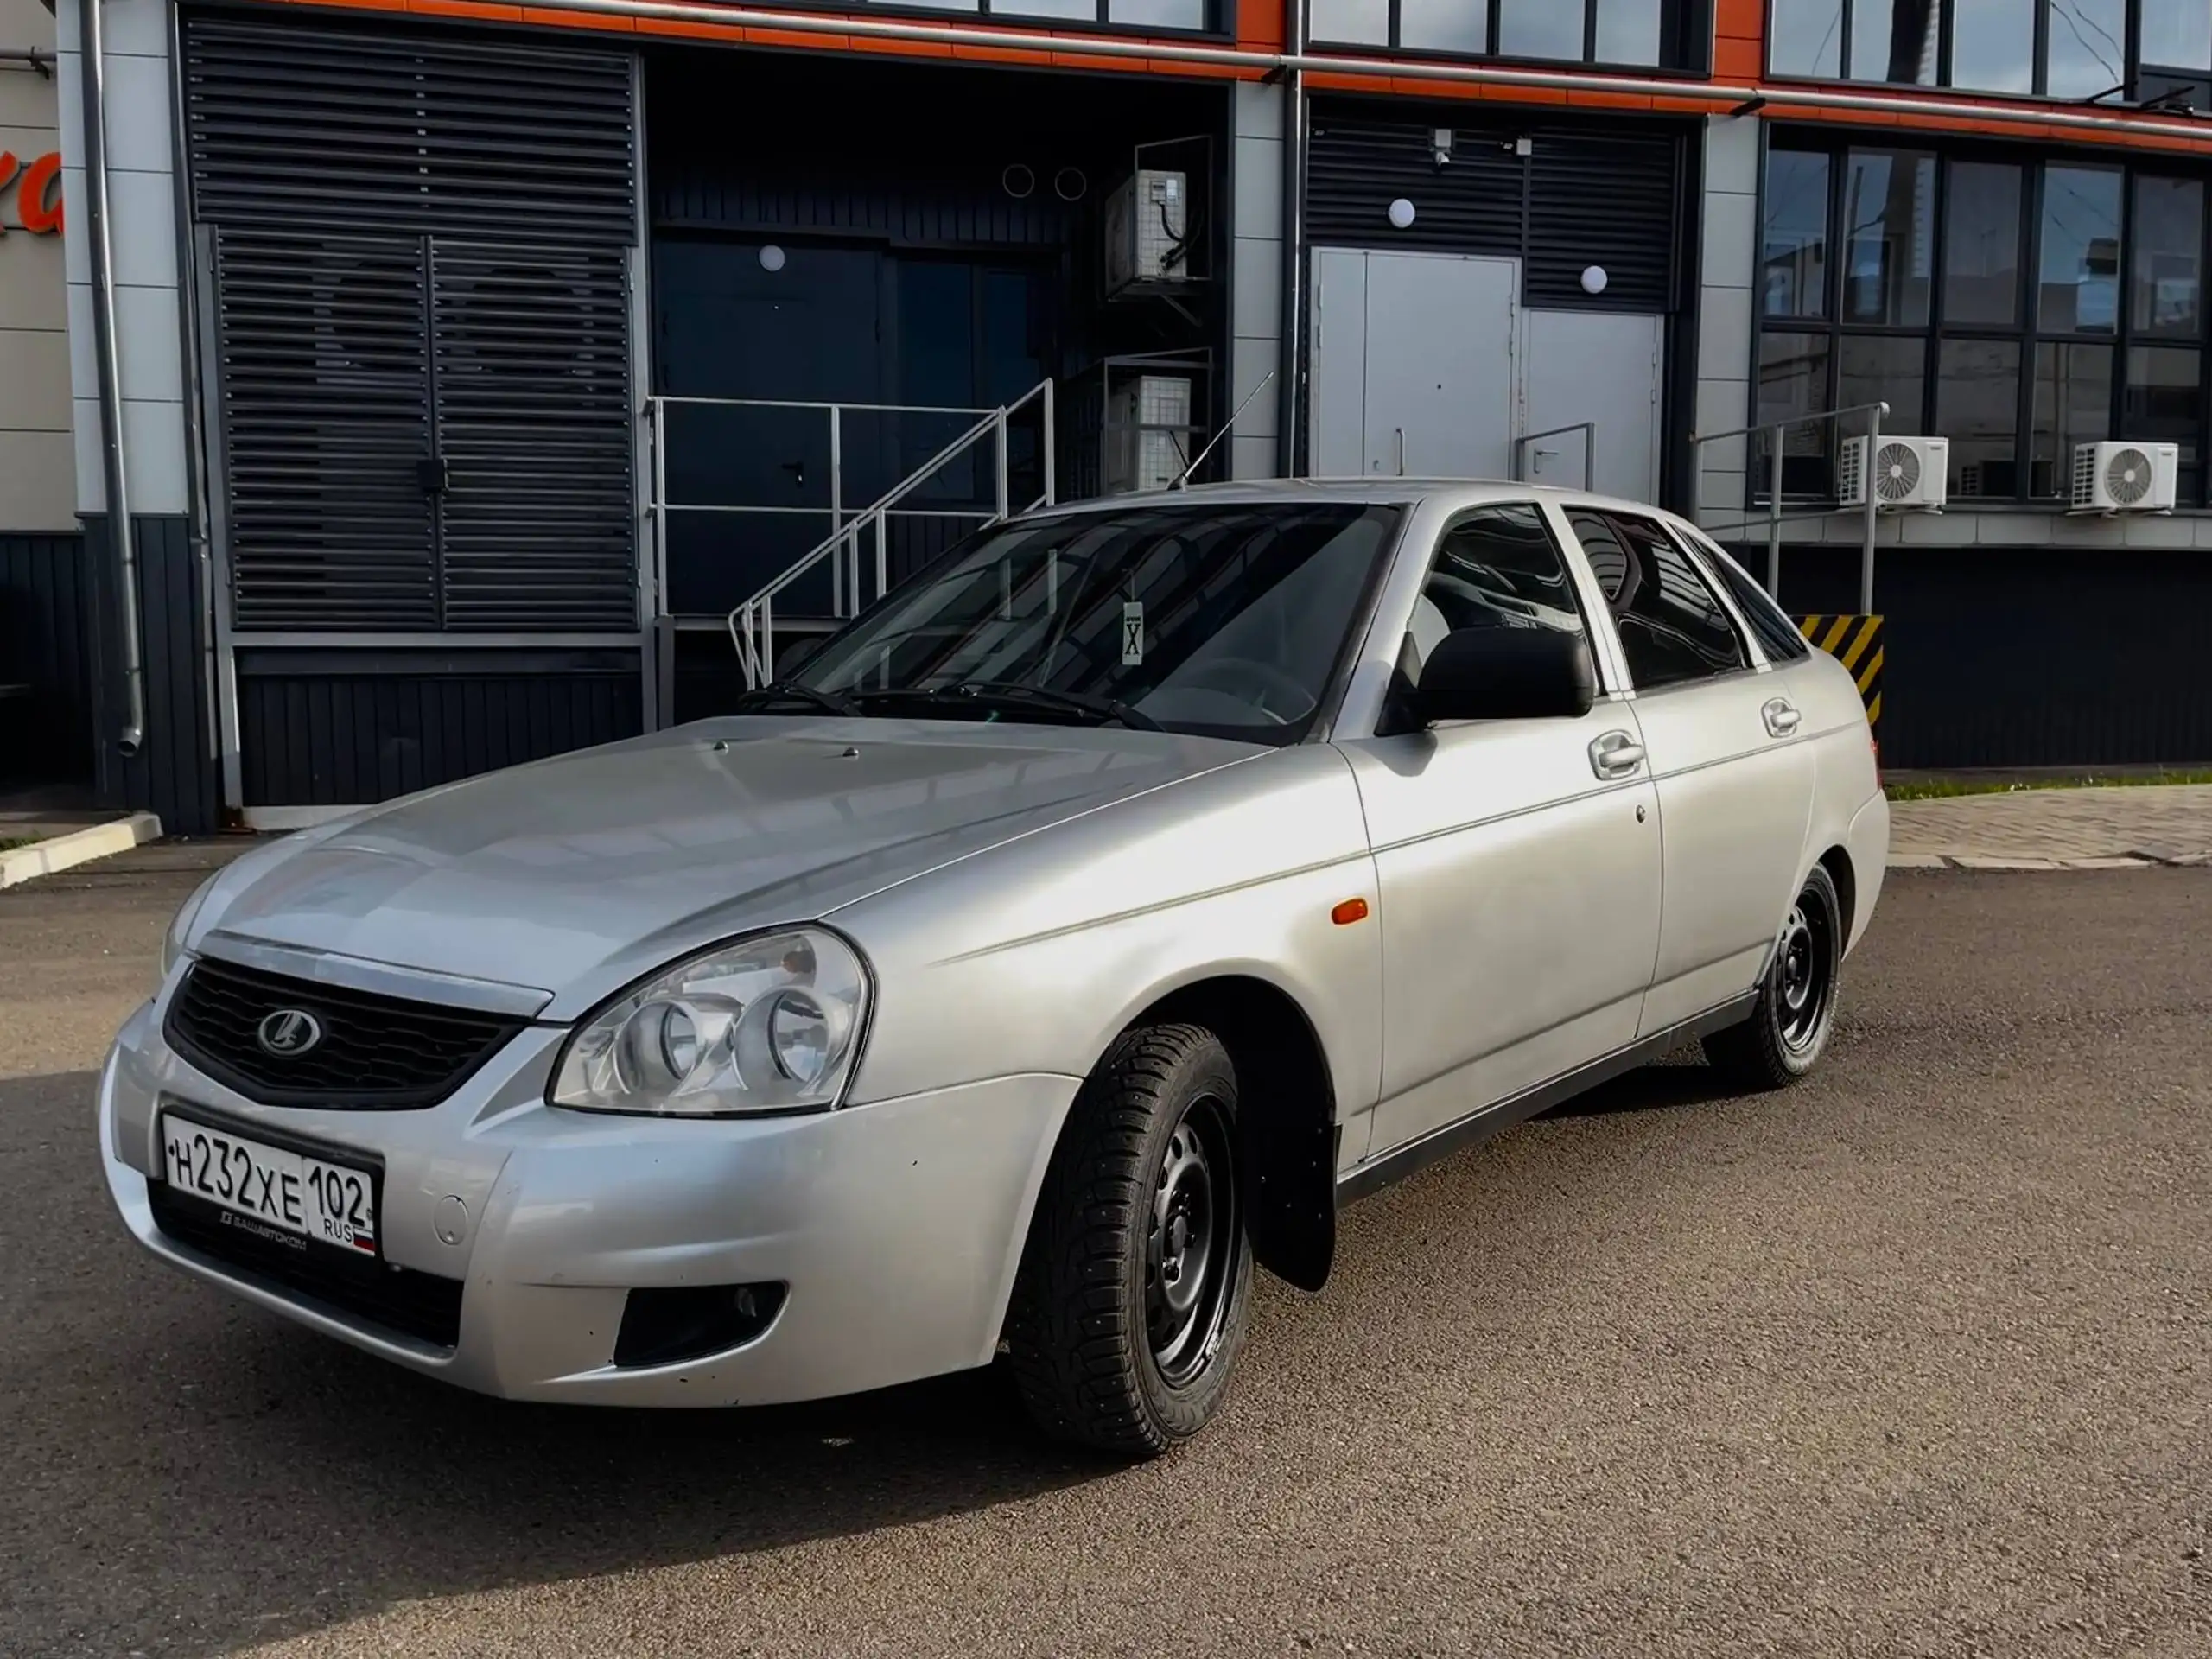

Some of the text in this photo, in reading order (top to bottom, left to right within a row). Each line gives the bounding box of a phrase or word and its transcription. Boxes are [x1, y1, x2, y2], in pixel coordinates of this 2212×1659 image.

[175, 1134, 366, 1228] Н232ХЕ 102
[324, 1217, 353, 1244] RUS
